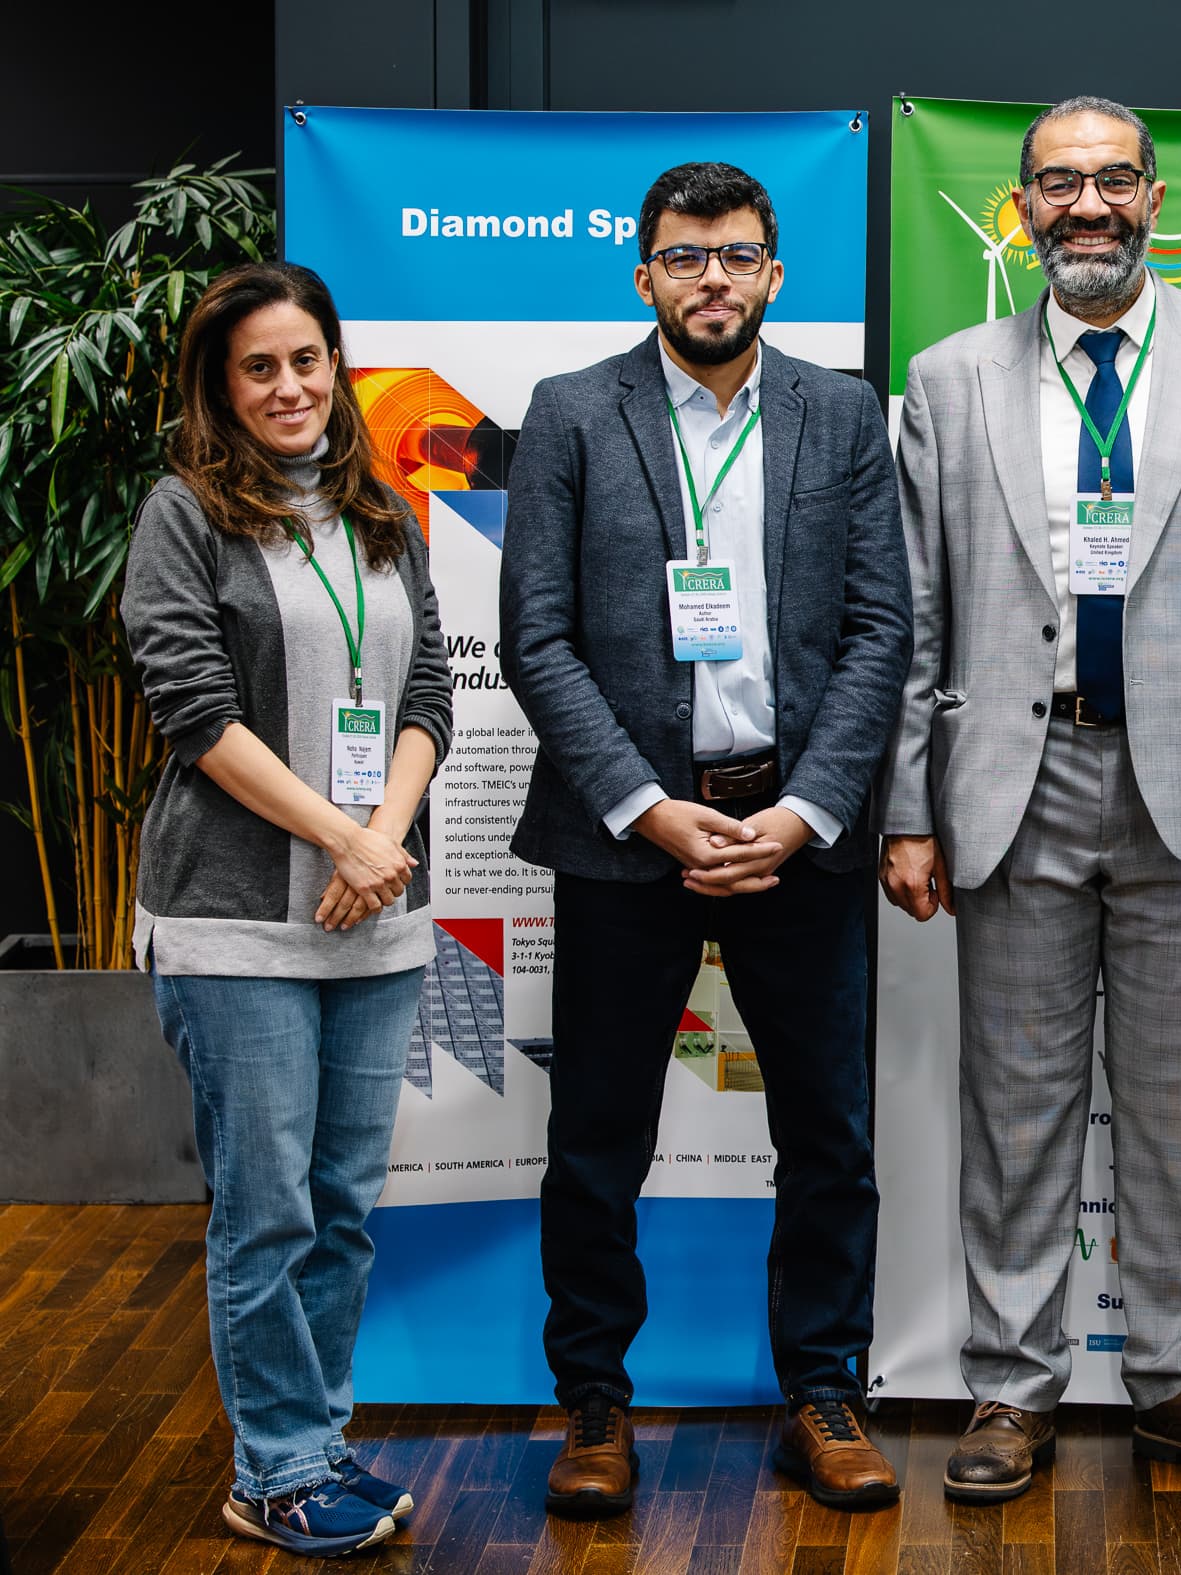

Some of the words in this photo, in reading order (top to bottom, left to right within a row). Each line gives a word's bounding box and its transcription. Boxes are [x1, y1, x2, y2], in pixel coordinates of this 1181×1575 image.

[402, 208, 574, 238] Diamond
[447, 635, 485, 658] We
[466, 728, 495, 739] global
[497, 728, 526, 737] leader
[456, 745, 509, 755] automation
[511, 745, 537, 755] throu
[445, 763, 463, 772] and
[464, 763, 507, 773] software,
[510, 764, 534, 774] powe
[445, 781, 479, 790] motors.
[481, 780, 516, 790] TMEIC's
[445, 798, 511, 807] infrastructures
[445, 816, 462, 825] and
[465, 815, 518, 826] consistently
[445, 833, 486, 842] solutions
[488, 832, 512, 842] unde
[445, 850, 463, 860] and
[465, 850, 517, 861] exceptiona
[445, 868, 451, 877] It
[455, 867, 461, 877] is
[463, 868, 487, 877] what
[489, 869, 503, 877] we
[505, 867, 520, 877] do.
[522, 867, 528, 876] It
[531, 867, 538, 876] is
[445, 887, 461, 895] our
[463, 884, 523, 896] never-ending
[525, 883, 554, 896] pursui
[511, 937, 536, 948] Tokyo
[537, 937, 554, 948] Squ
[511, 951, 532, 961] 3-1-1
[534, 951, 555, 962] Kyob
[512, 965, 550, 975] 104-0031,
[435, 1161, 464, 1171] SOUTH
[465, 1159, 504, 1169] AMERICA
[515, 1156, 548, 1167] EUROPE
[675, 1154, 703, 1163] CHINA
[714, 1154, 747, 1163] MIDDLE
[751, 1155, 773, 1163] EAST
